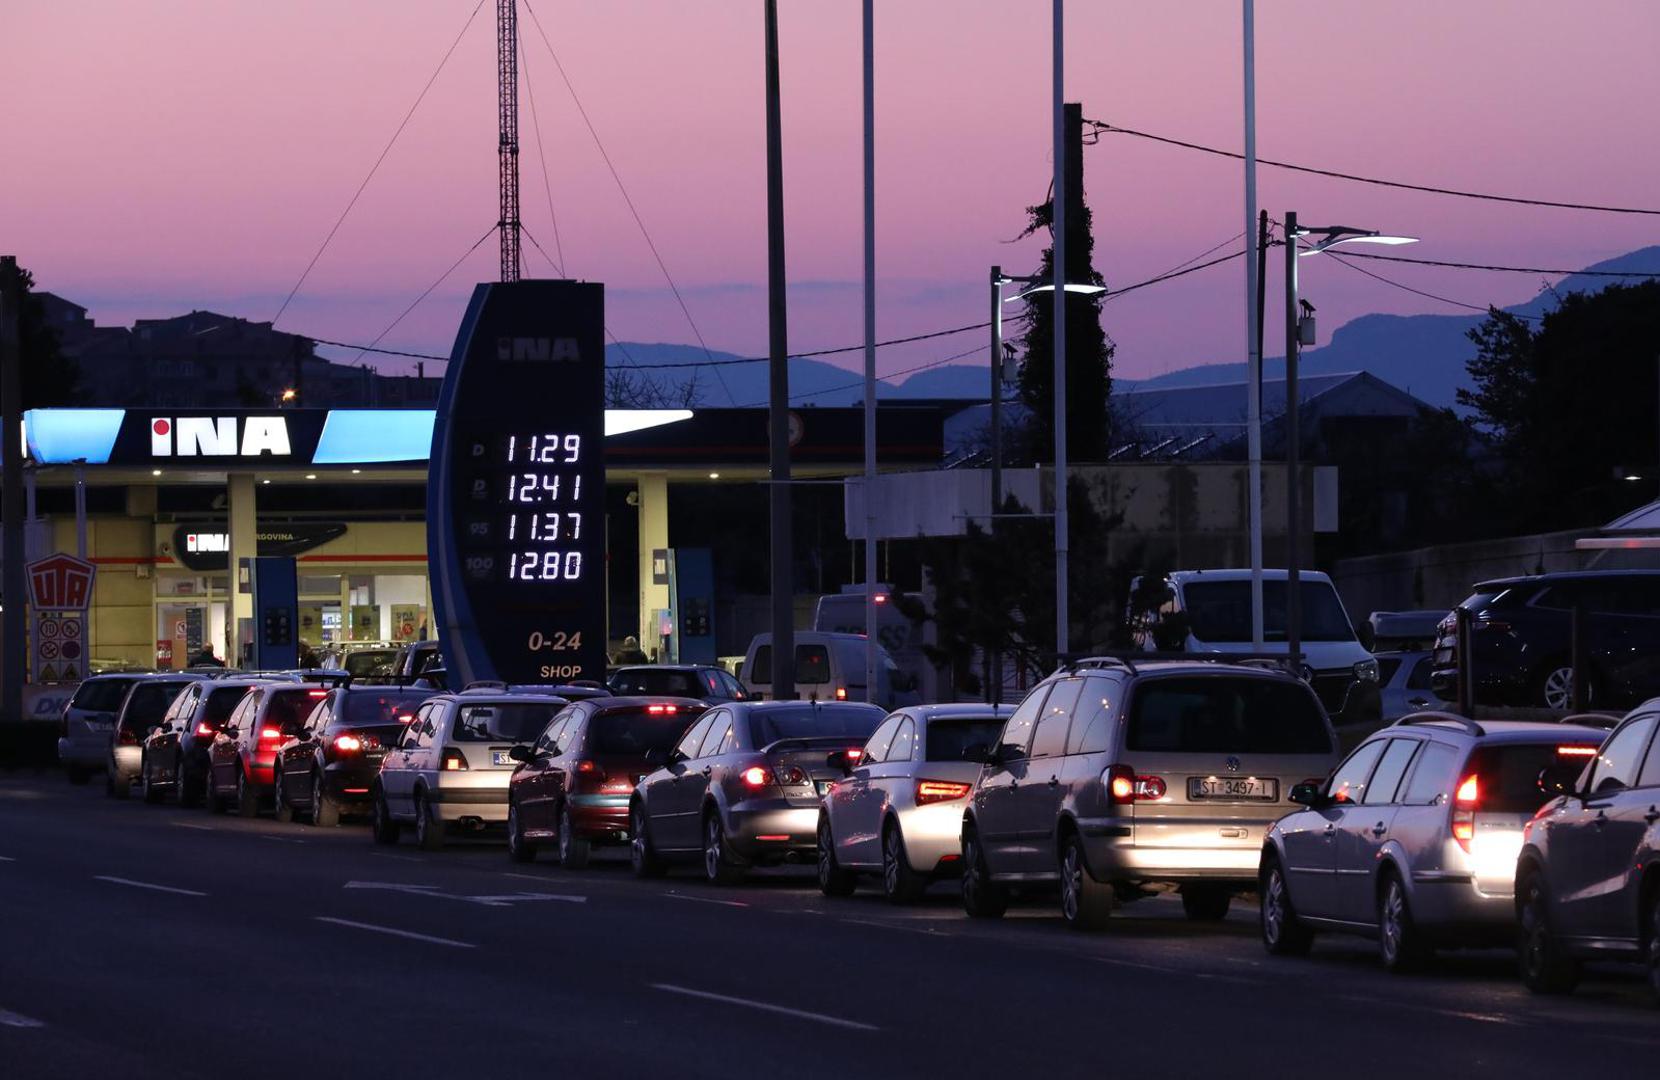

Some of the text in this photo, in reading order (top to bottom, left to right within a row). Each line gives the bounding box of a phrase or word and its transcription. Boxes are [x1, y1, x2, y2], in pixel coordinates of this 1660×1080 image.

[473, 434, 581, 463] D 11.29
[508, 473, 581, 502] 12.41
[470, 512, 581, 541] 95 11.37
[467, 551, 582, 580] 100 12.80
[31, 558, 91, 608] UTA
[528, 631, 582, 651] 0-24
[540, 665, 582, 678] SHOP
[1202, 781, 1216, 794] ST
